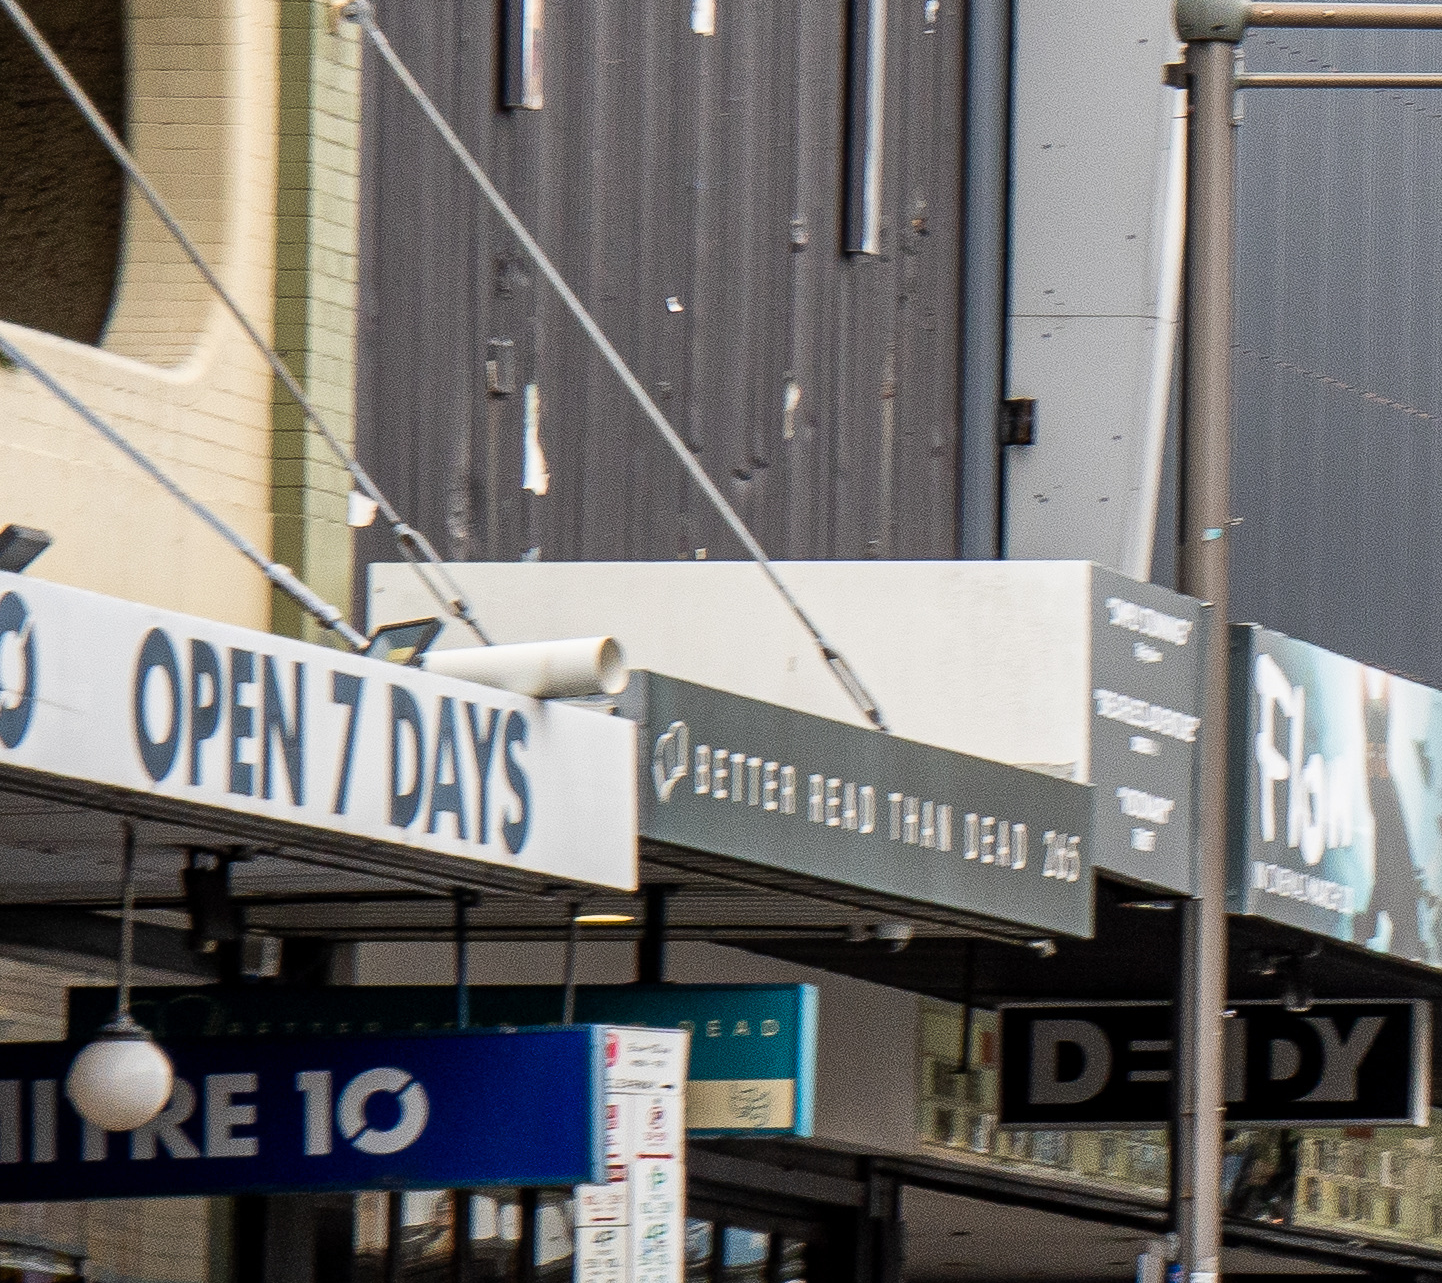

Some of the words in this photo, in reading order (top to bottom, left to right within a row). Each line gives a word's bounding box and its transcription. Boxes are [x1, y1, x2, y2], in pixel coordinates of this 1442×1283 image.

[134, 627, 307, 807] OPEN
[332, 674, 369, 816] 7
[388, 683, 533, 856] DAYS
[694, 744, 797, 815] BETTER
[808, 773, 876, 835] READ
[888, 791, 953, 853] THAN
[964, 812, 1029, 870] DEAD
